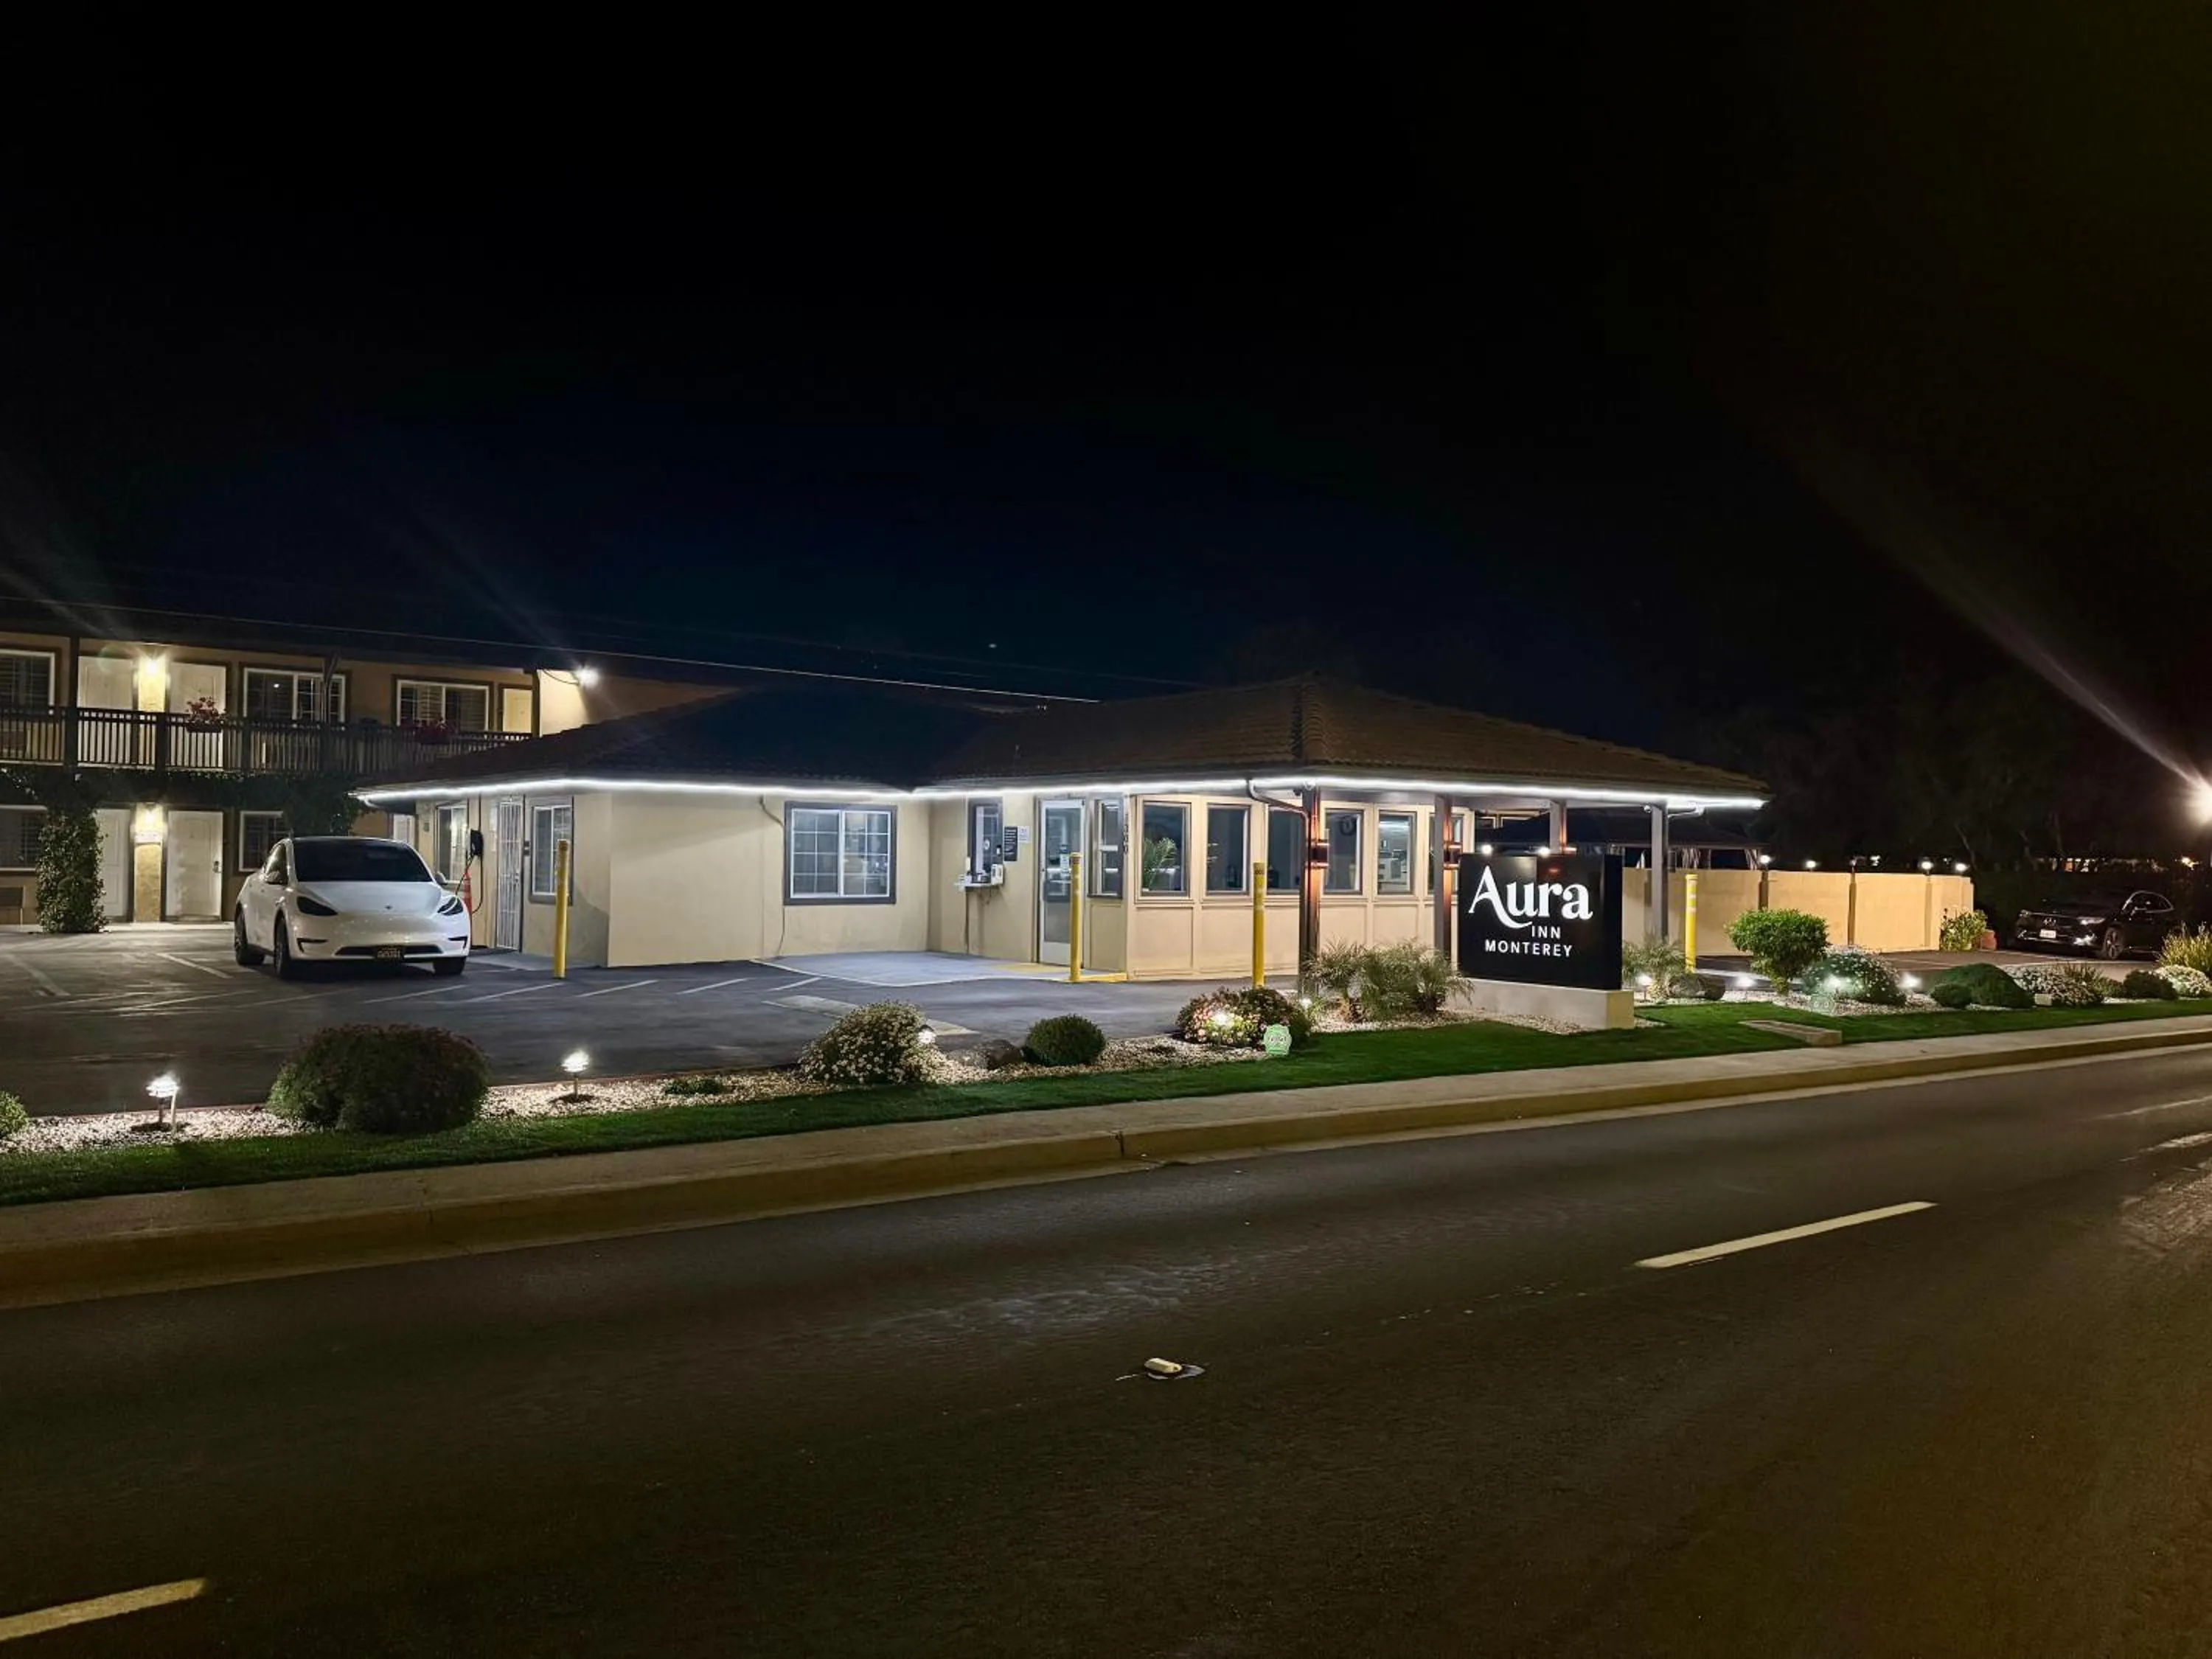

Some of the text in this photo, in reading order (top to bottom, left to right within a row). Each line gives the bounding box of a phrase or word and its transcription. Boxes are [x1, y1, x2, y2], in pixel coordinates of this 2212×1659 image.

[1468, 865, 1593, 929] Aura
[1531, 925, 1561, 939] INN
[1485, 939, 1573, 957] MONTEREY
